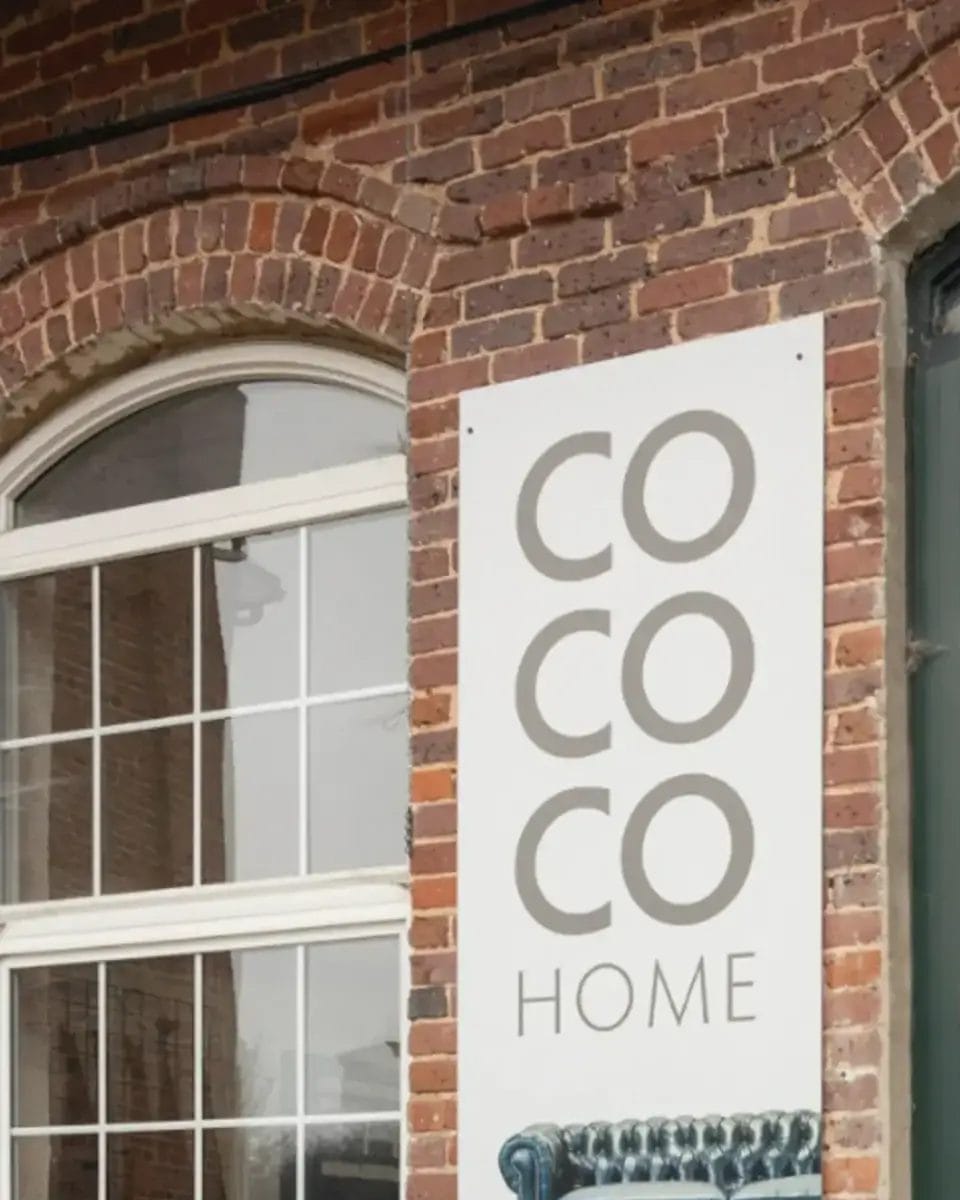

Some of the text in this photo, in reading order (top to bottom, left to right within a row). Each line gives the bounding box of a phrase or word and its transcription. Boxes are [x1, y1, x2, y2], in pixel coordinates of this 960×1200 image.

[515, 409, 756, 582] CO
[514, 591, 755, 759] CO
[514, 772, 755, 936] CO
[517, 952, 757, 1037] HOME
